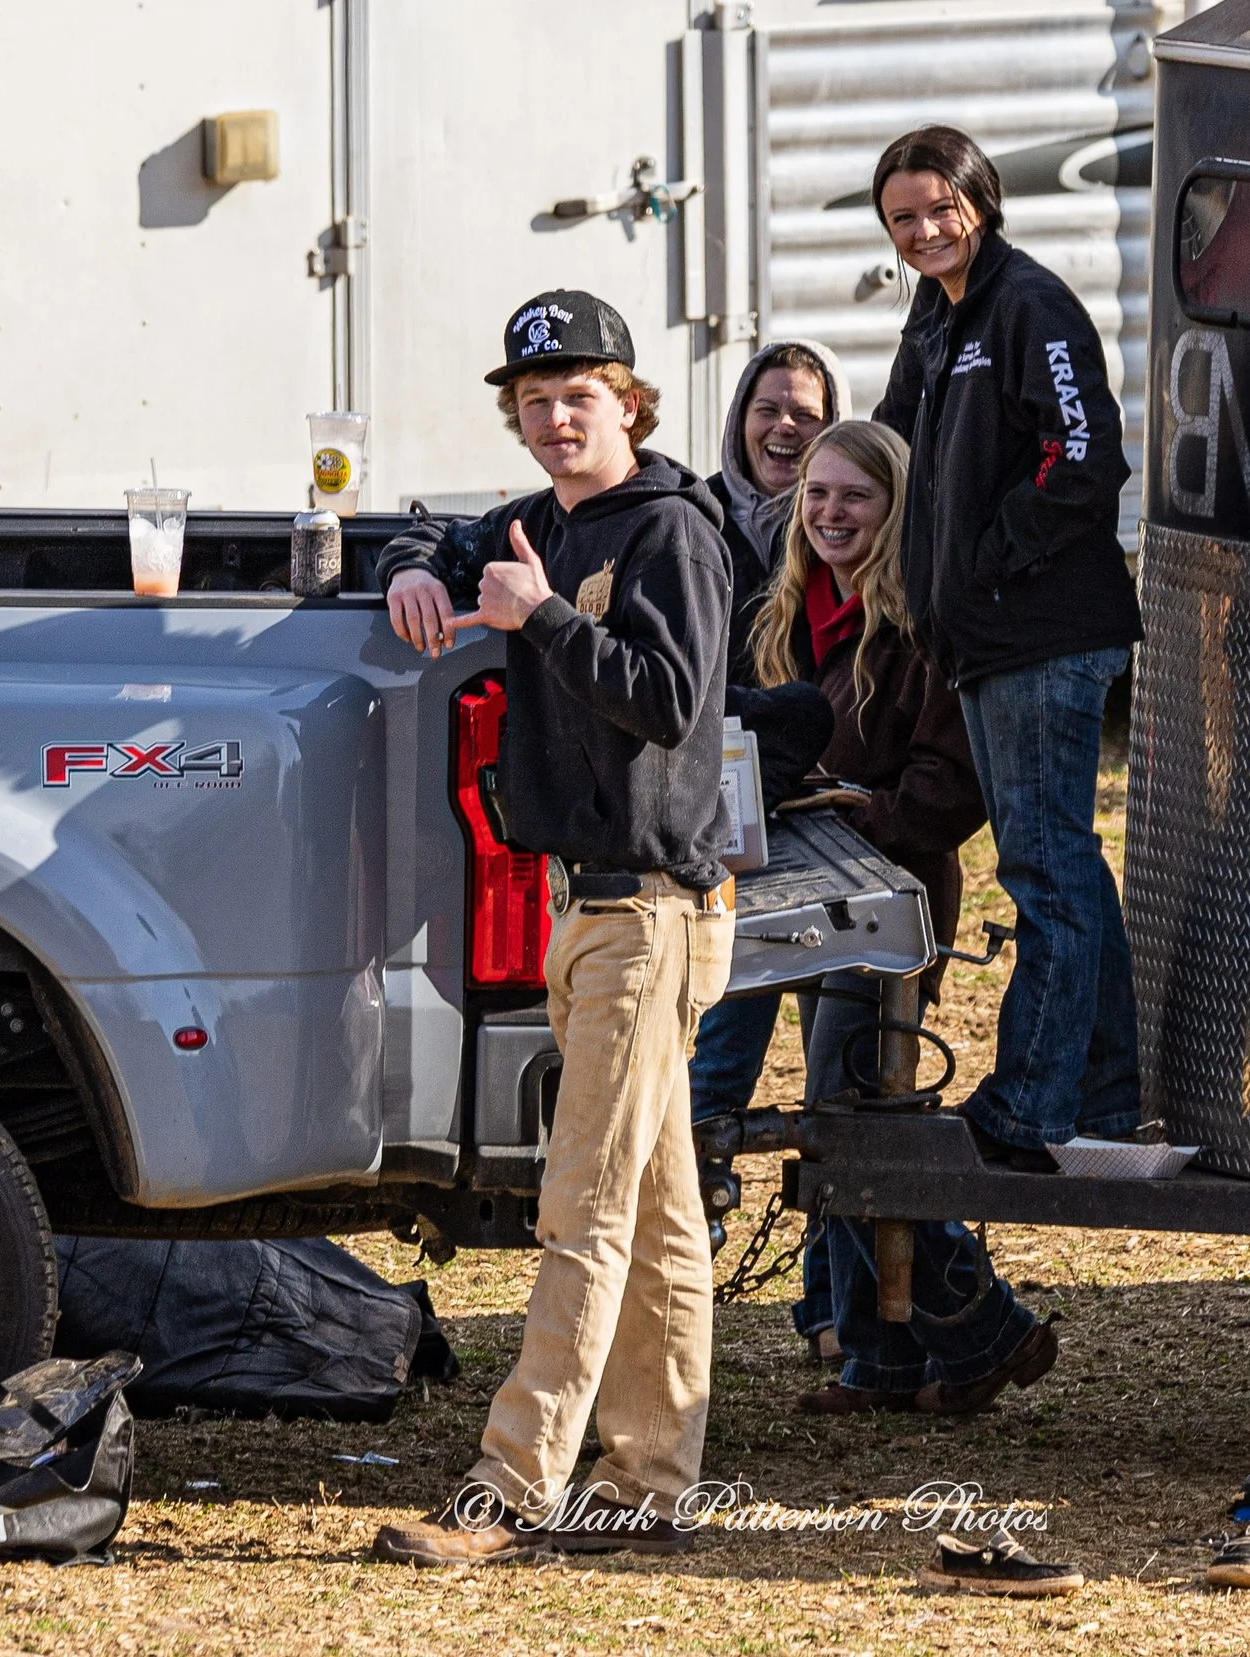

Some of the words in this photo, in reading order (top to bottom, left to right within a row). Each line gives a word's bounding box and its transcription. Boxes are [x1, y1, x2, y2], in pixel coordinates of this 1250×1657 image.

[521, 345, 540, 357] HAT
[544, 339, 562, 350] CO.
[40, 740, 244, 789] FX4
